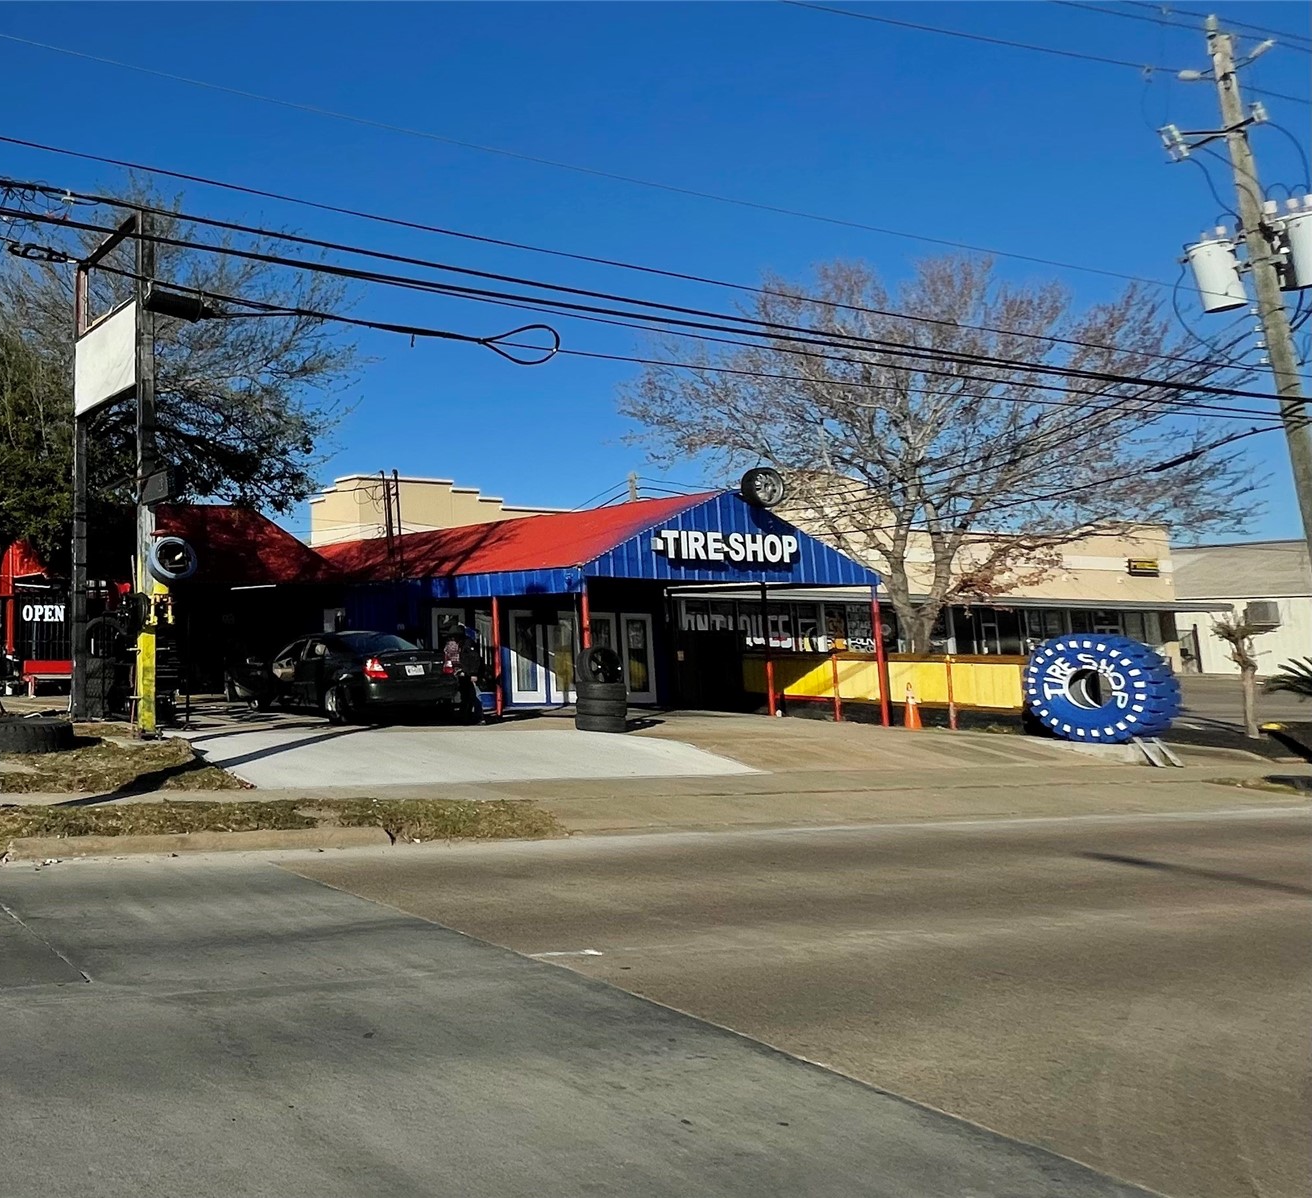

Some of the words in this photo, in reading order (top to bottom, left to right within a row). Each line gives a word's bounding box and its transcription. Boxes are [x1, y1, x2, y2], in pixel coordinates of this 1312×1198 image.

[728, 533, 798, 563] SHOP
[22, 604, 66, 622] OPEN
[1043, 657, 1077, 700] TIRE
[1077, 653, 1129, 709] SHOP
